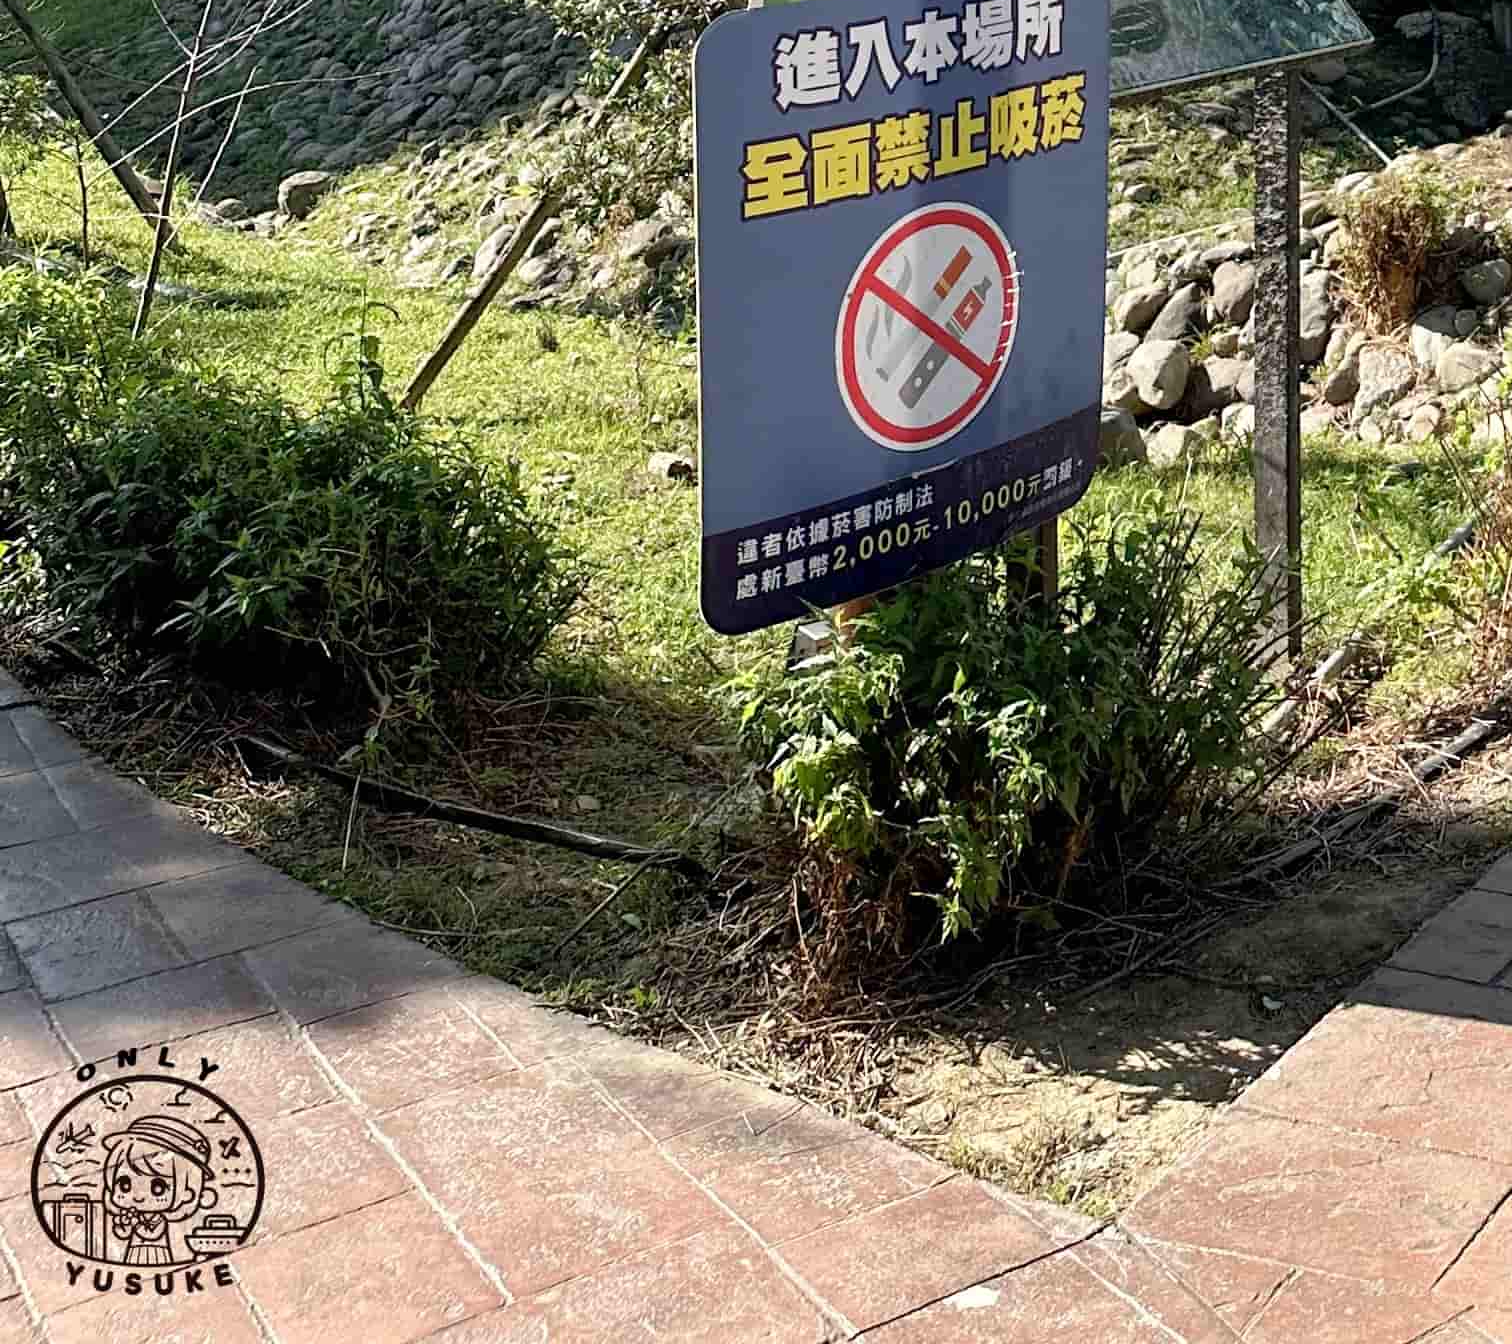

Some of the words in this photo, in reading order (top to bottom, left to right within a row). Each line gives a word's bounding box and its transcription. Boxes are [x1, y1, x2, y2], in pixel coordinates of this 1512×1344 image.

[742, 74, 1087, 219] 全面禁止吸菸
